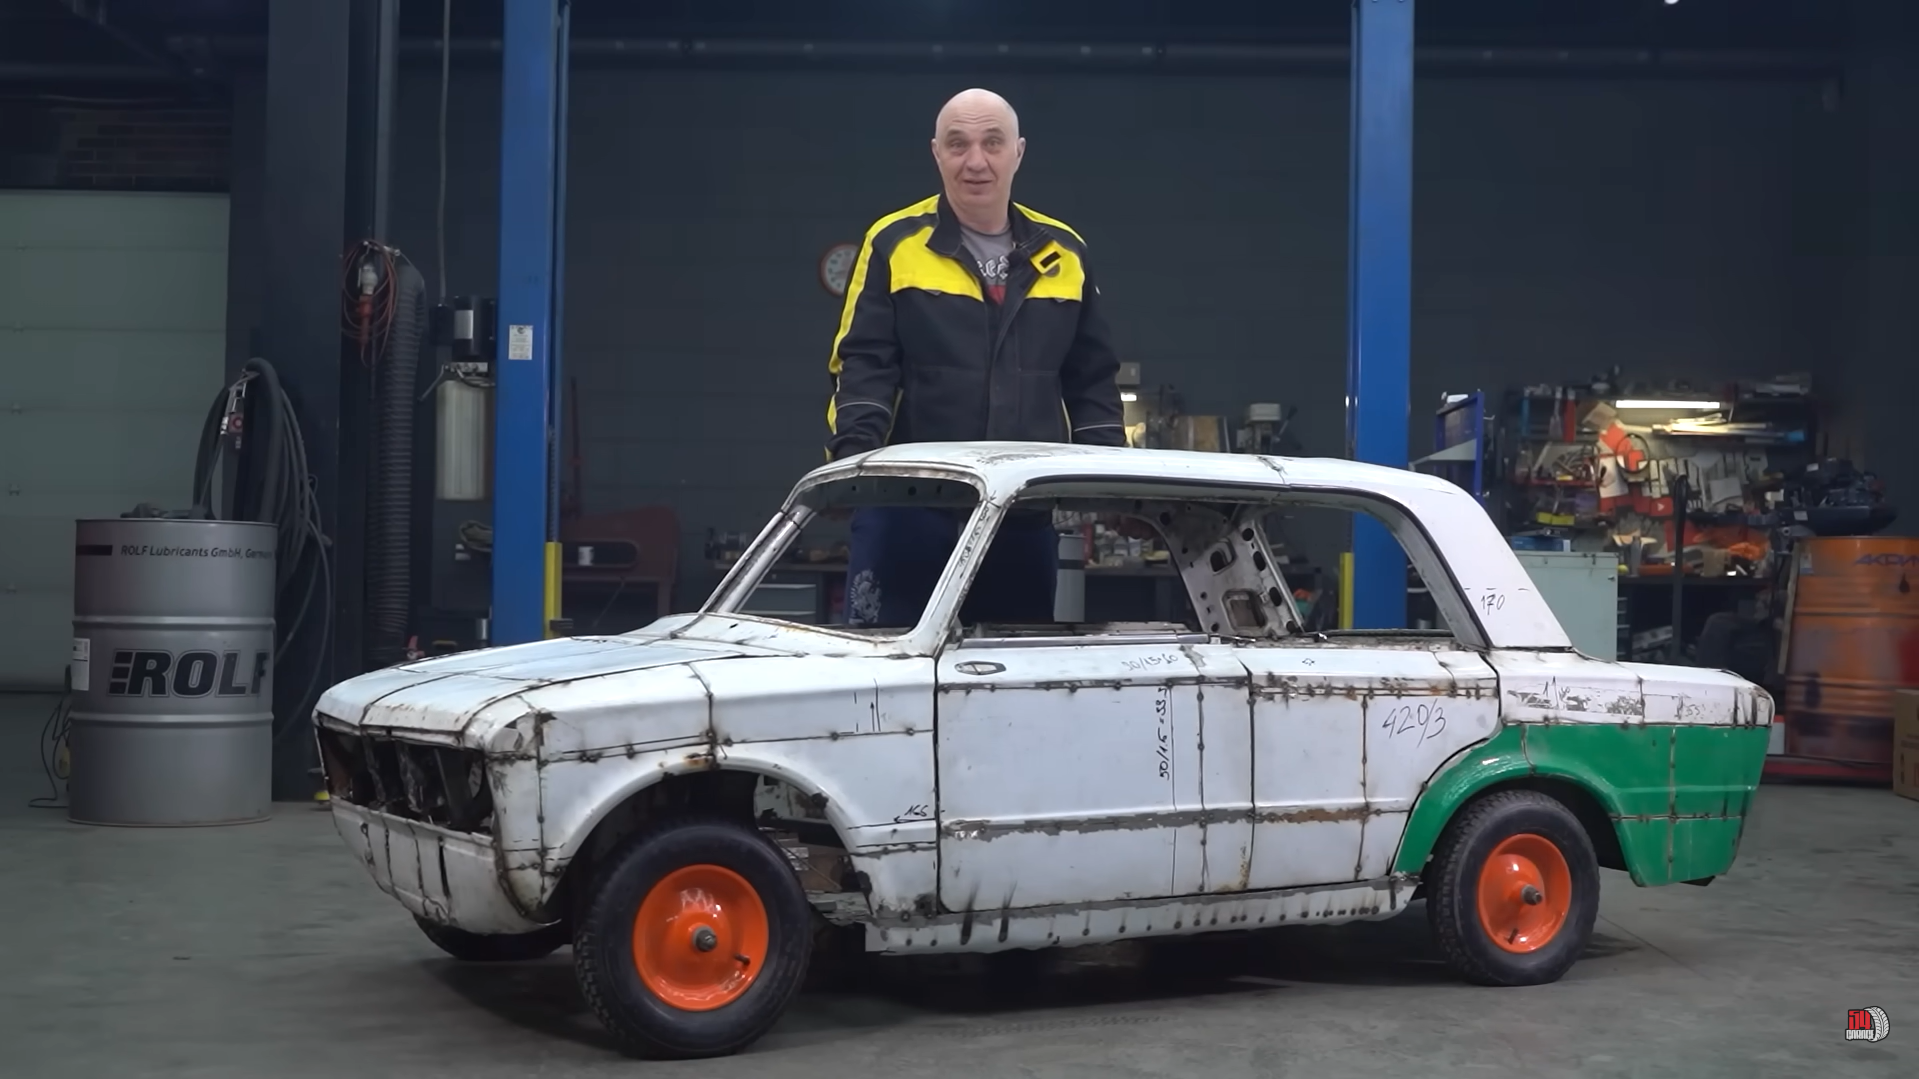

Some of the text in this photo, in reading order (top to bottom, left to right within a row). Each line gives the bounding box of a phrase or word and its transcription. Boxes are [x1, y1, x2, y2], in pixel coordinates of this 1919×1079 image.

[120, 545, 148, 556] ROLF
[150, 545, 208, 557] Lubricants
[211, 547, 243, 559] GmbH,
[1480, 593, 1505, 615] 170
[126, 650, 270, 697] ROLF
[1382, 698, 1446, 748] 420/3
